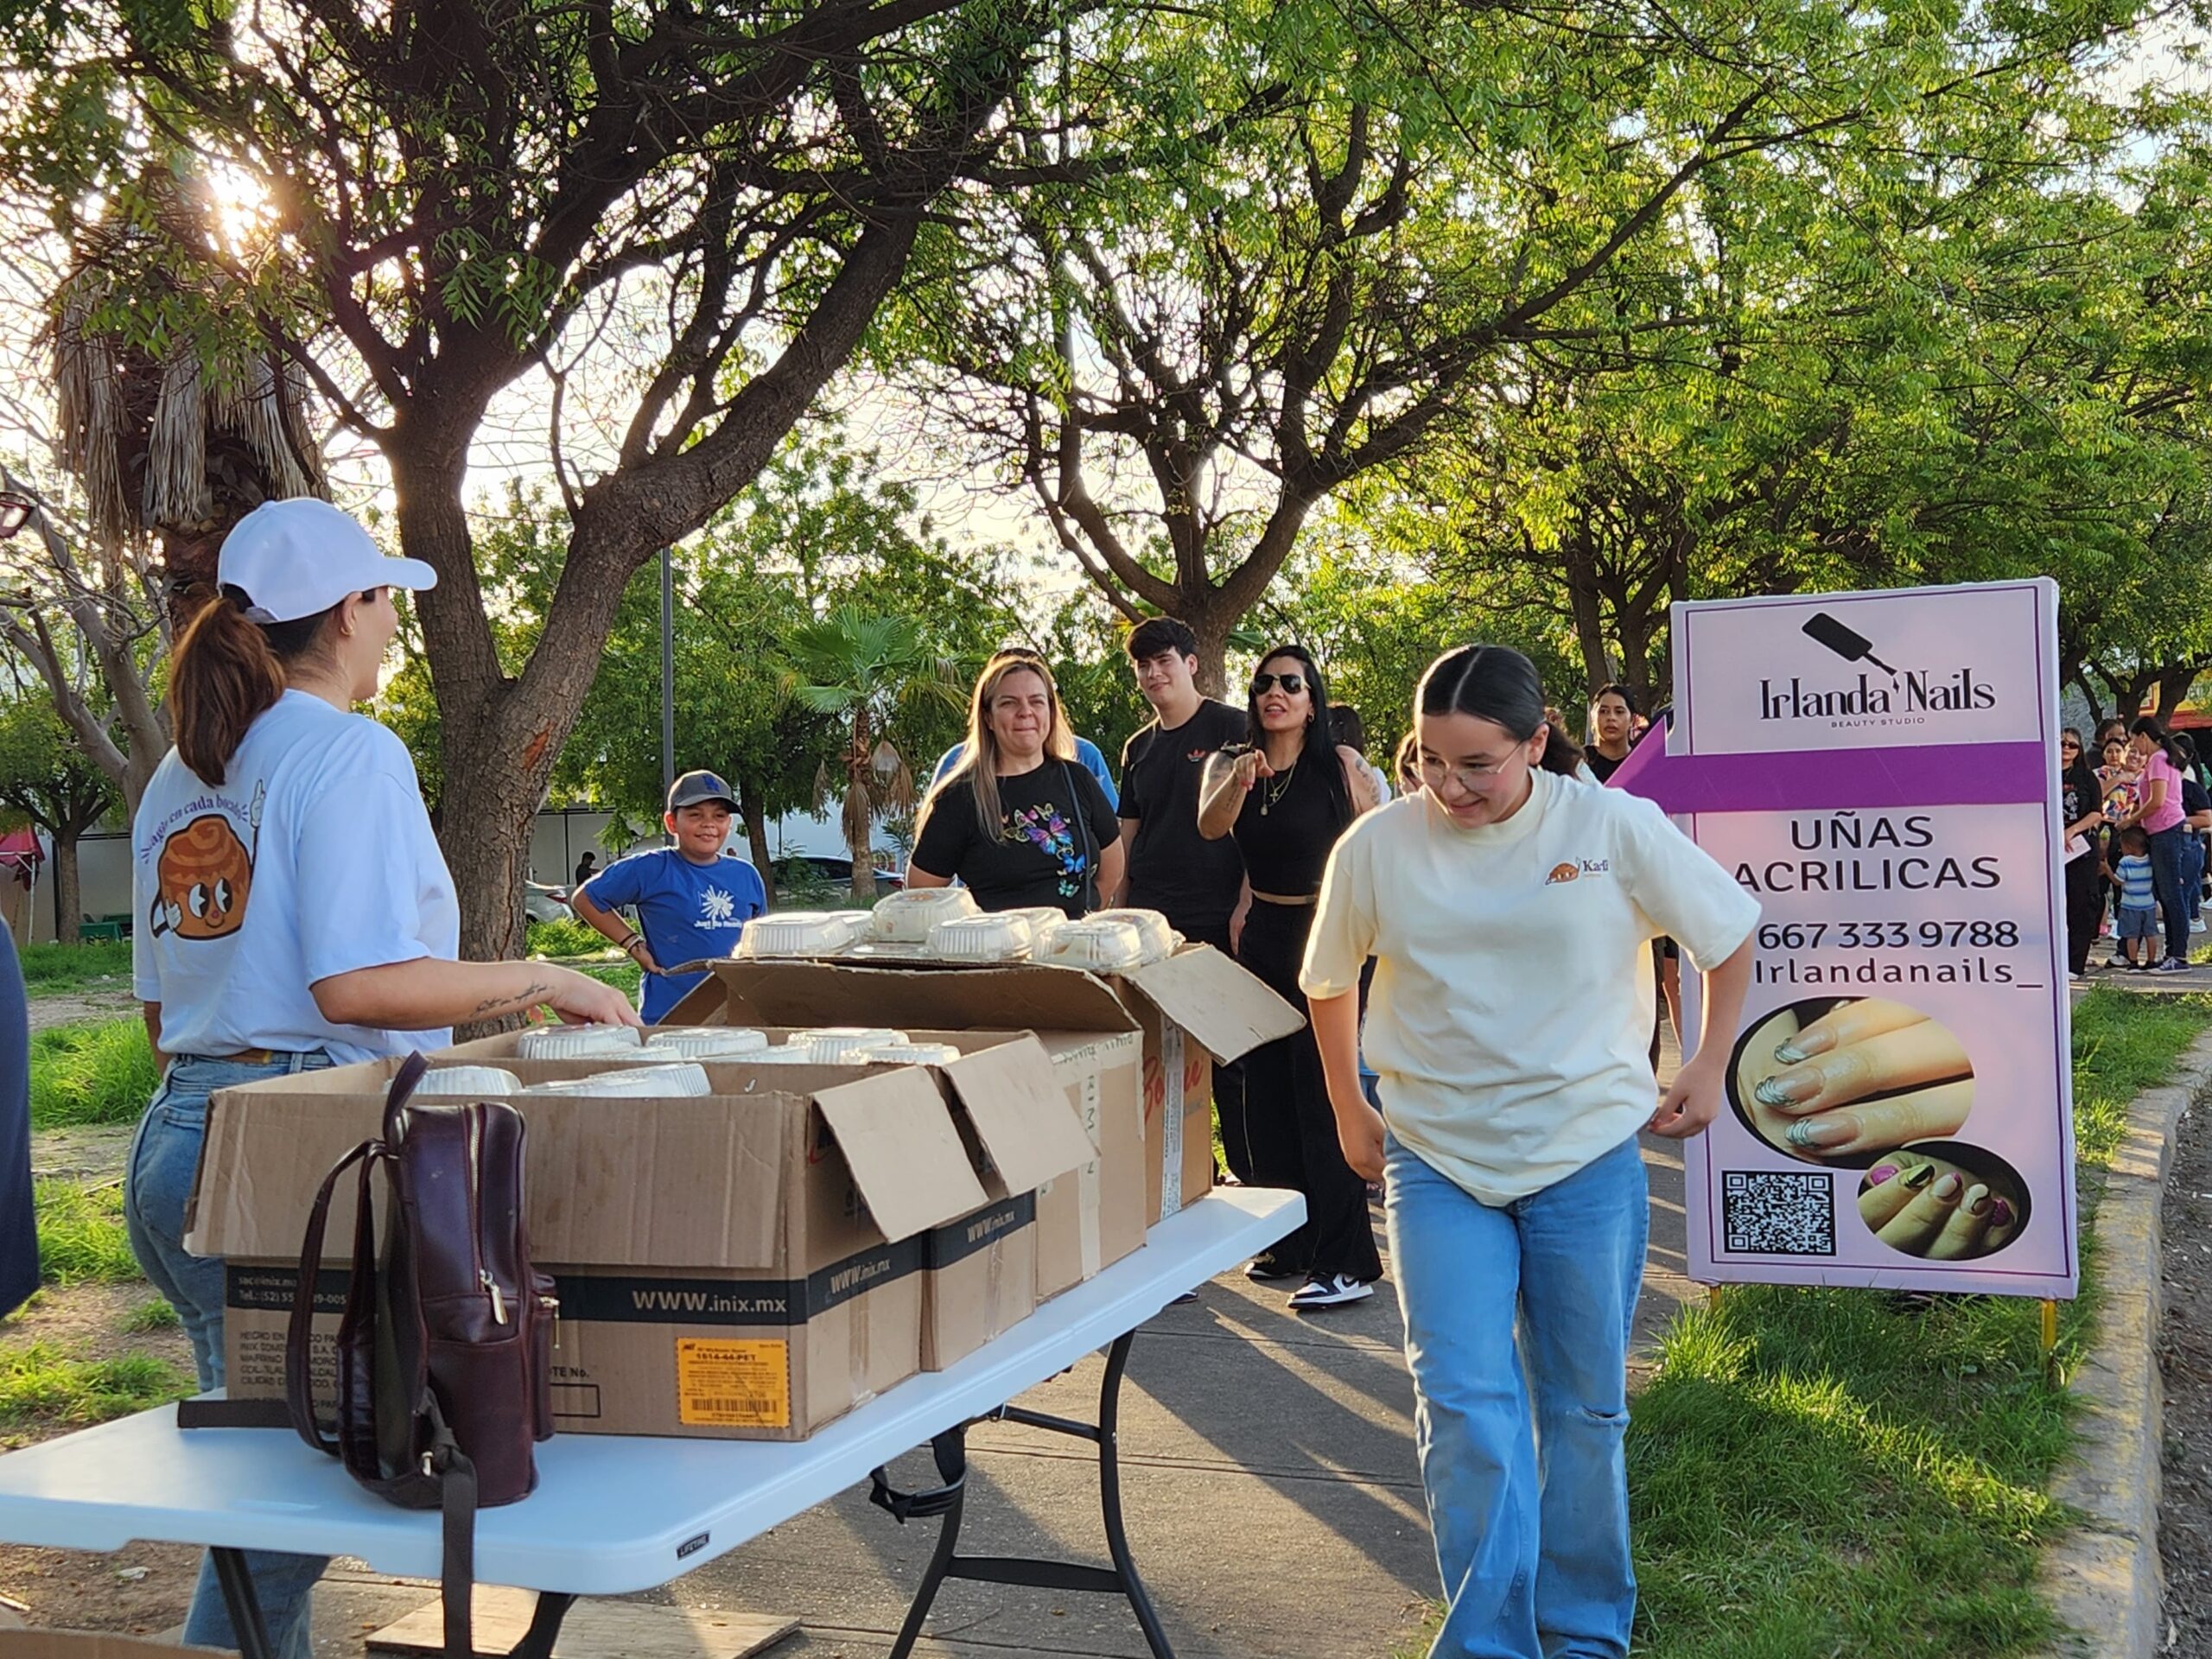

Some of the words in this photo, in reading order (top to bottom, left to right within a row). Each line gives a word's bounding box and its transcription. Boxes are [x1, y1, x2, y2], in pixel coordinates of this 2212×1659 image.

[1759, 673, 1891, 720] Irlanda
[1904, 667, 1996, 713] Nails
[1831, 719, 1875, 728] BEAUTY
[1880, 716, 1925, 726] STUDIO
[184, 795, 214, 815] cada
[1790, 810, 1934, 850] UÑAS
[1734, 856, 2001, 893] ACRILICAS
[1758, 923, 1827, 950] 667
[1838, 922, 1910, 949] 333
[1918, 920, 2020, 948] 9788
[1755, 957, 2044, 988] Irlandanails_
